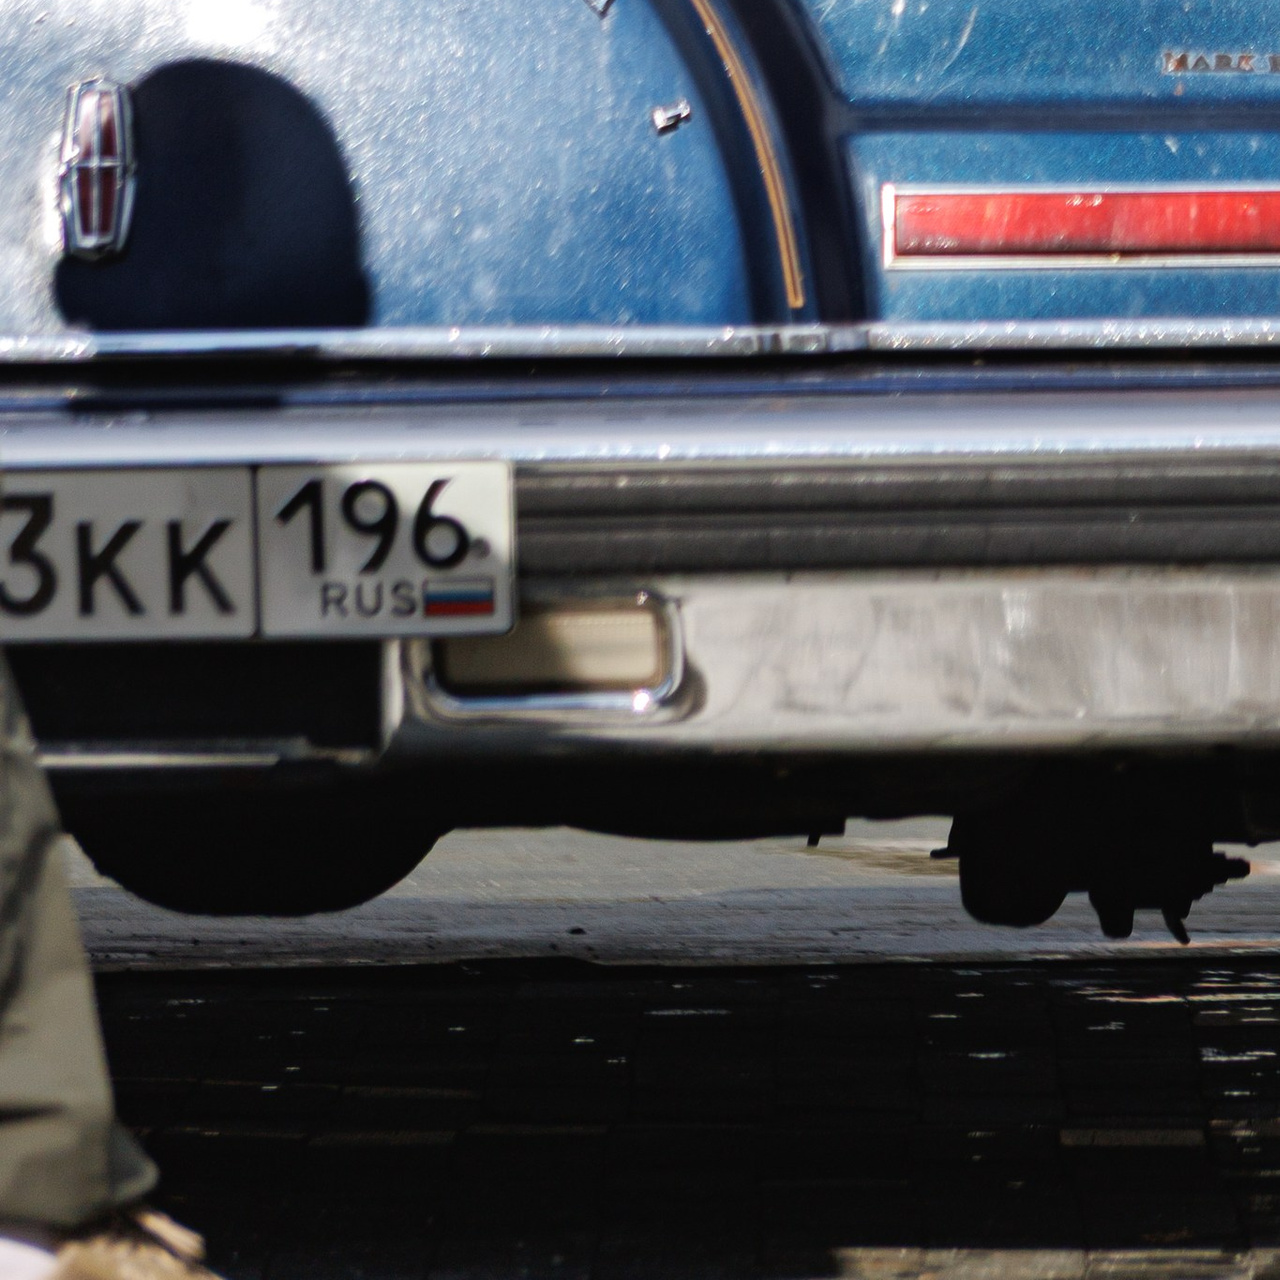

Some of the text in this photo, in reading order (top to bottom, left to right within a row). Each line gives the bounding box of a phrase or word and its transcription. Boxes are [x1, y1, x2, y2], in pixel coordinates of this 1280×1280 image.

[1162, 51, 1254, 74] MARK
[275, 478, 470, 573] 196
[320, 582, 418, 618] RUS
